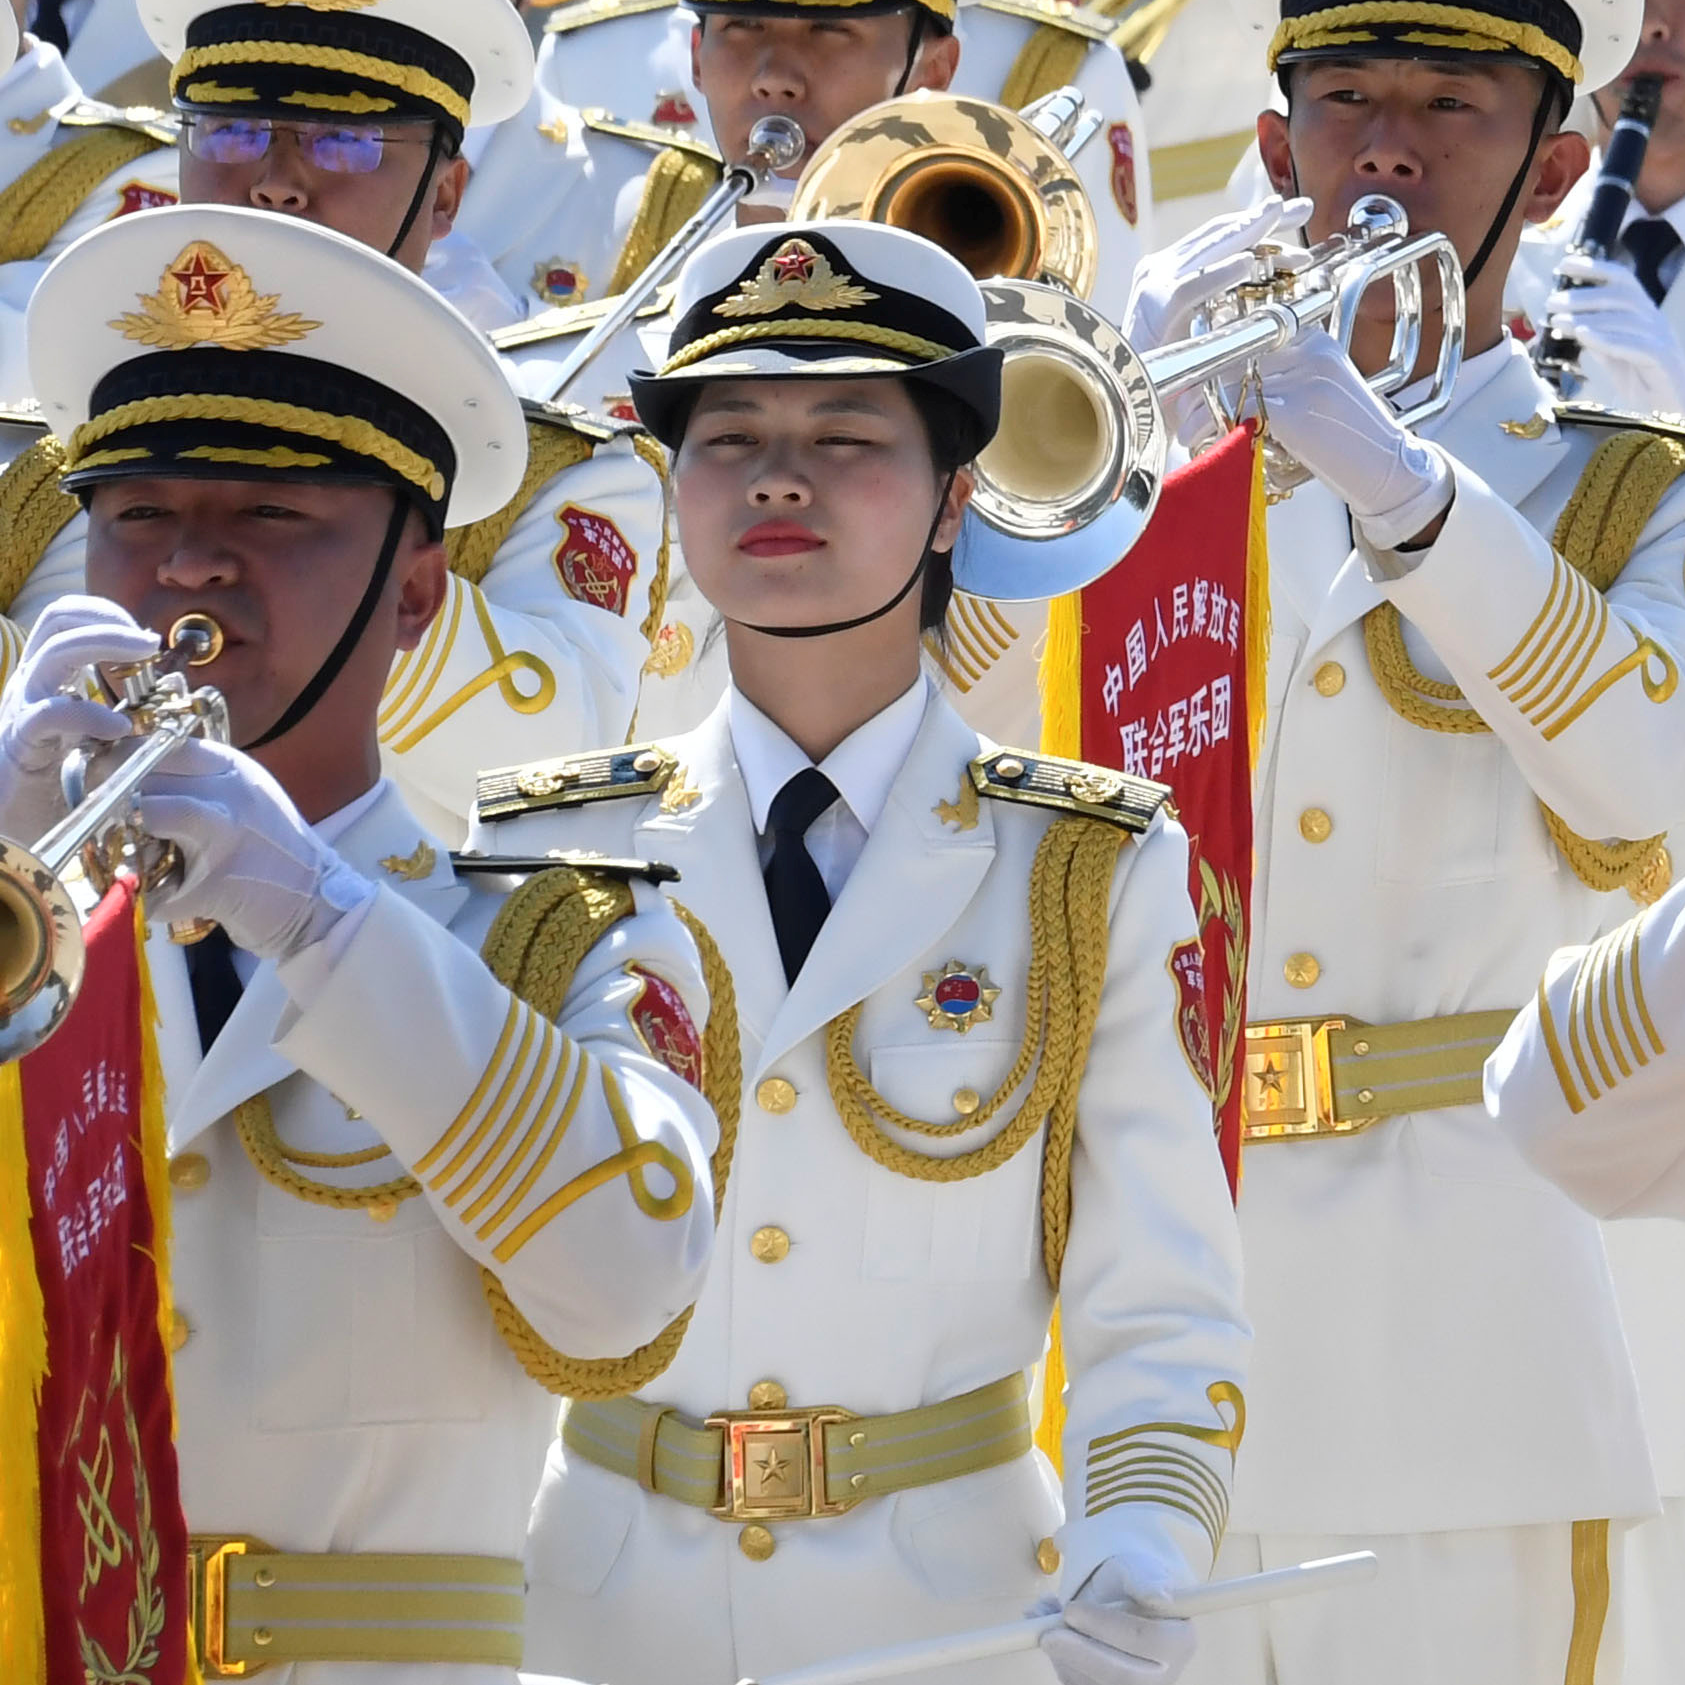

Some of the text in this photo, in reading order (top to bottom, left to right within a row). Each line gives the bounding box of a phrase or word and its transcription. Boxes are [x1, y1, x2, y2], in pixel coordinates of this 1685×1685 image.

[1102, 576, 1240, 718] 中国人民解放军
[1120, 674, 1231, 779] 联合军乐团
